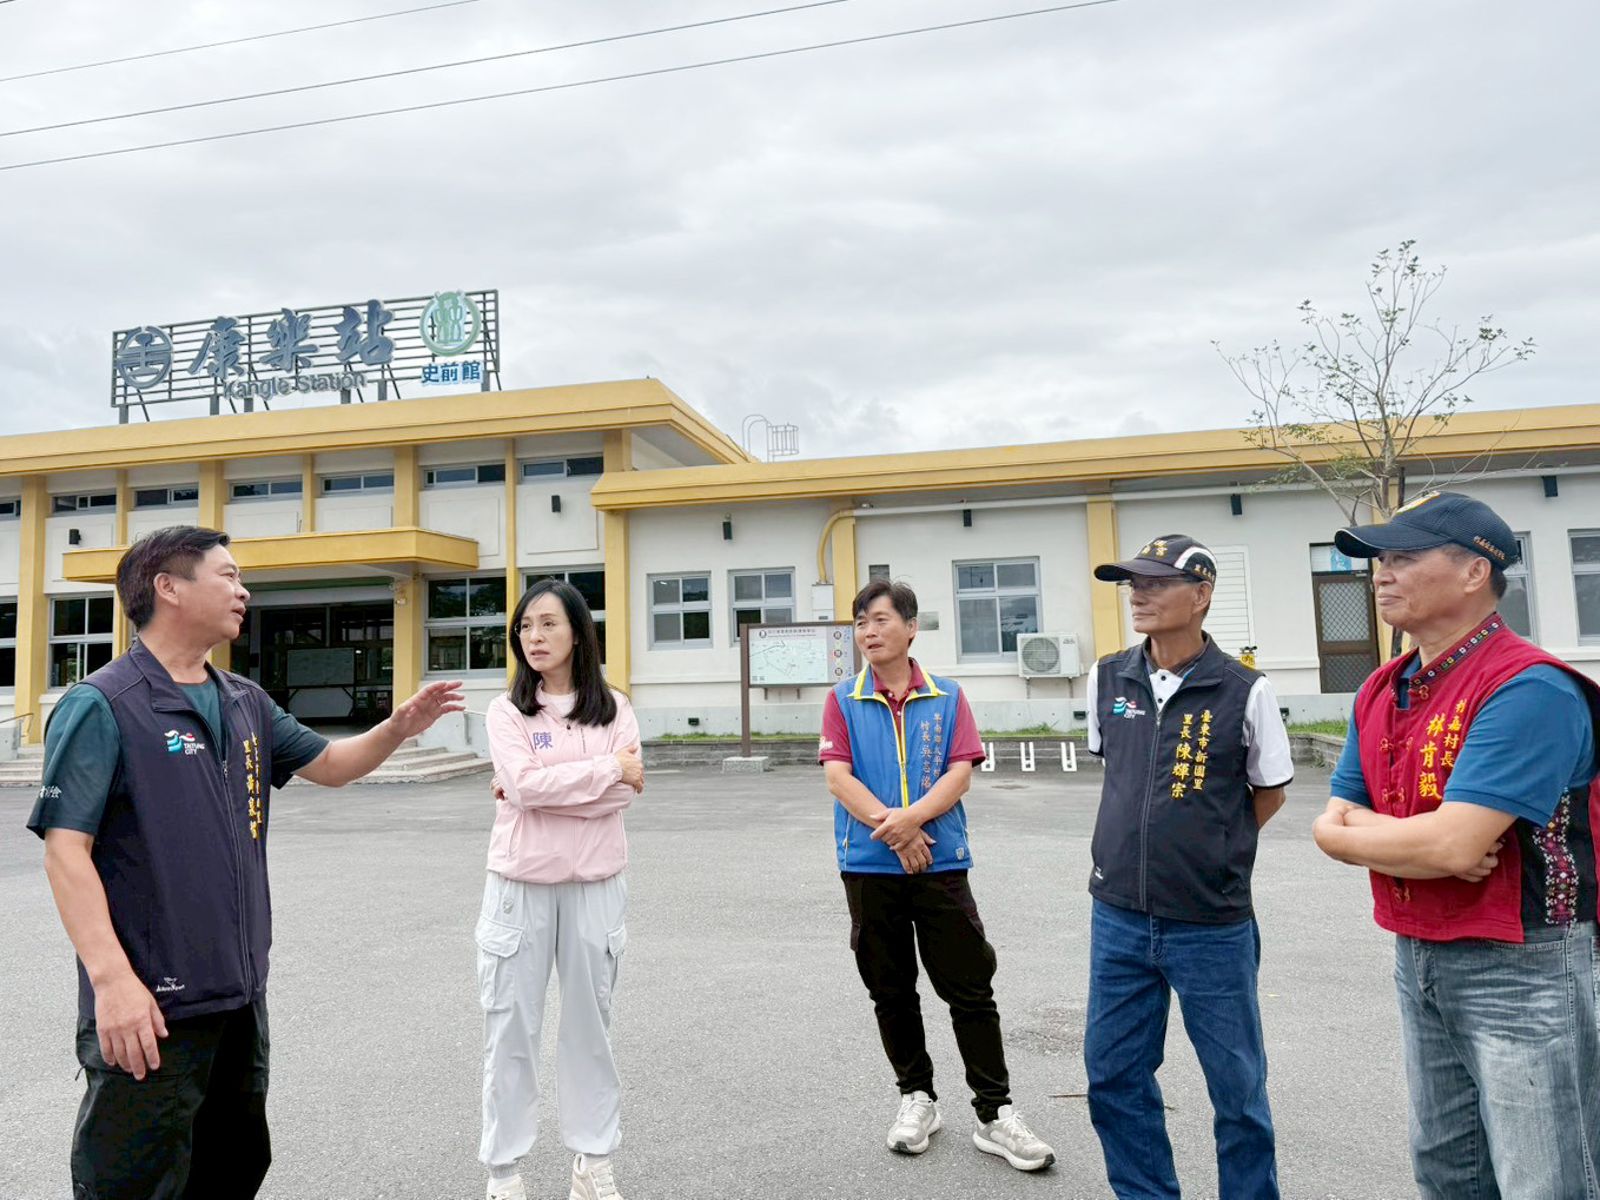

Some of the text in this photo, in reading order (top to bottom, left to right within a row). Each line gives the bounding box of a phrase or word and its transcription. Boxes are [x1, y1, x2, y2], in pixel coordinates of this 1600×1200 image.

[187, 299, 396, 380] 康樂站
[222, 370, 367, 402] Kangle Station
[420, 361, 482, 384] 史前館
[532, 732, 553, 750] 陳
